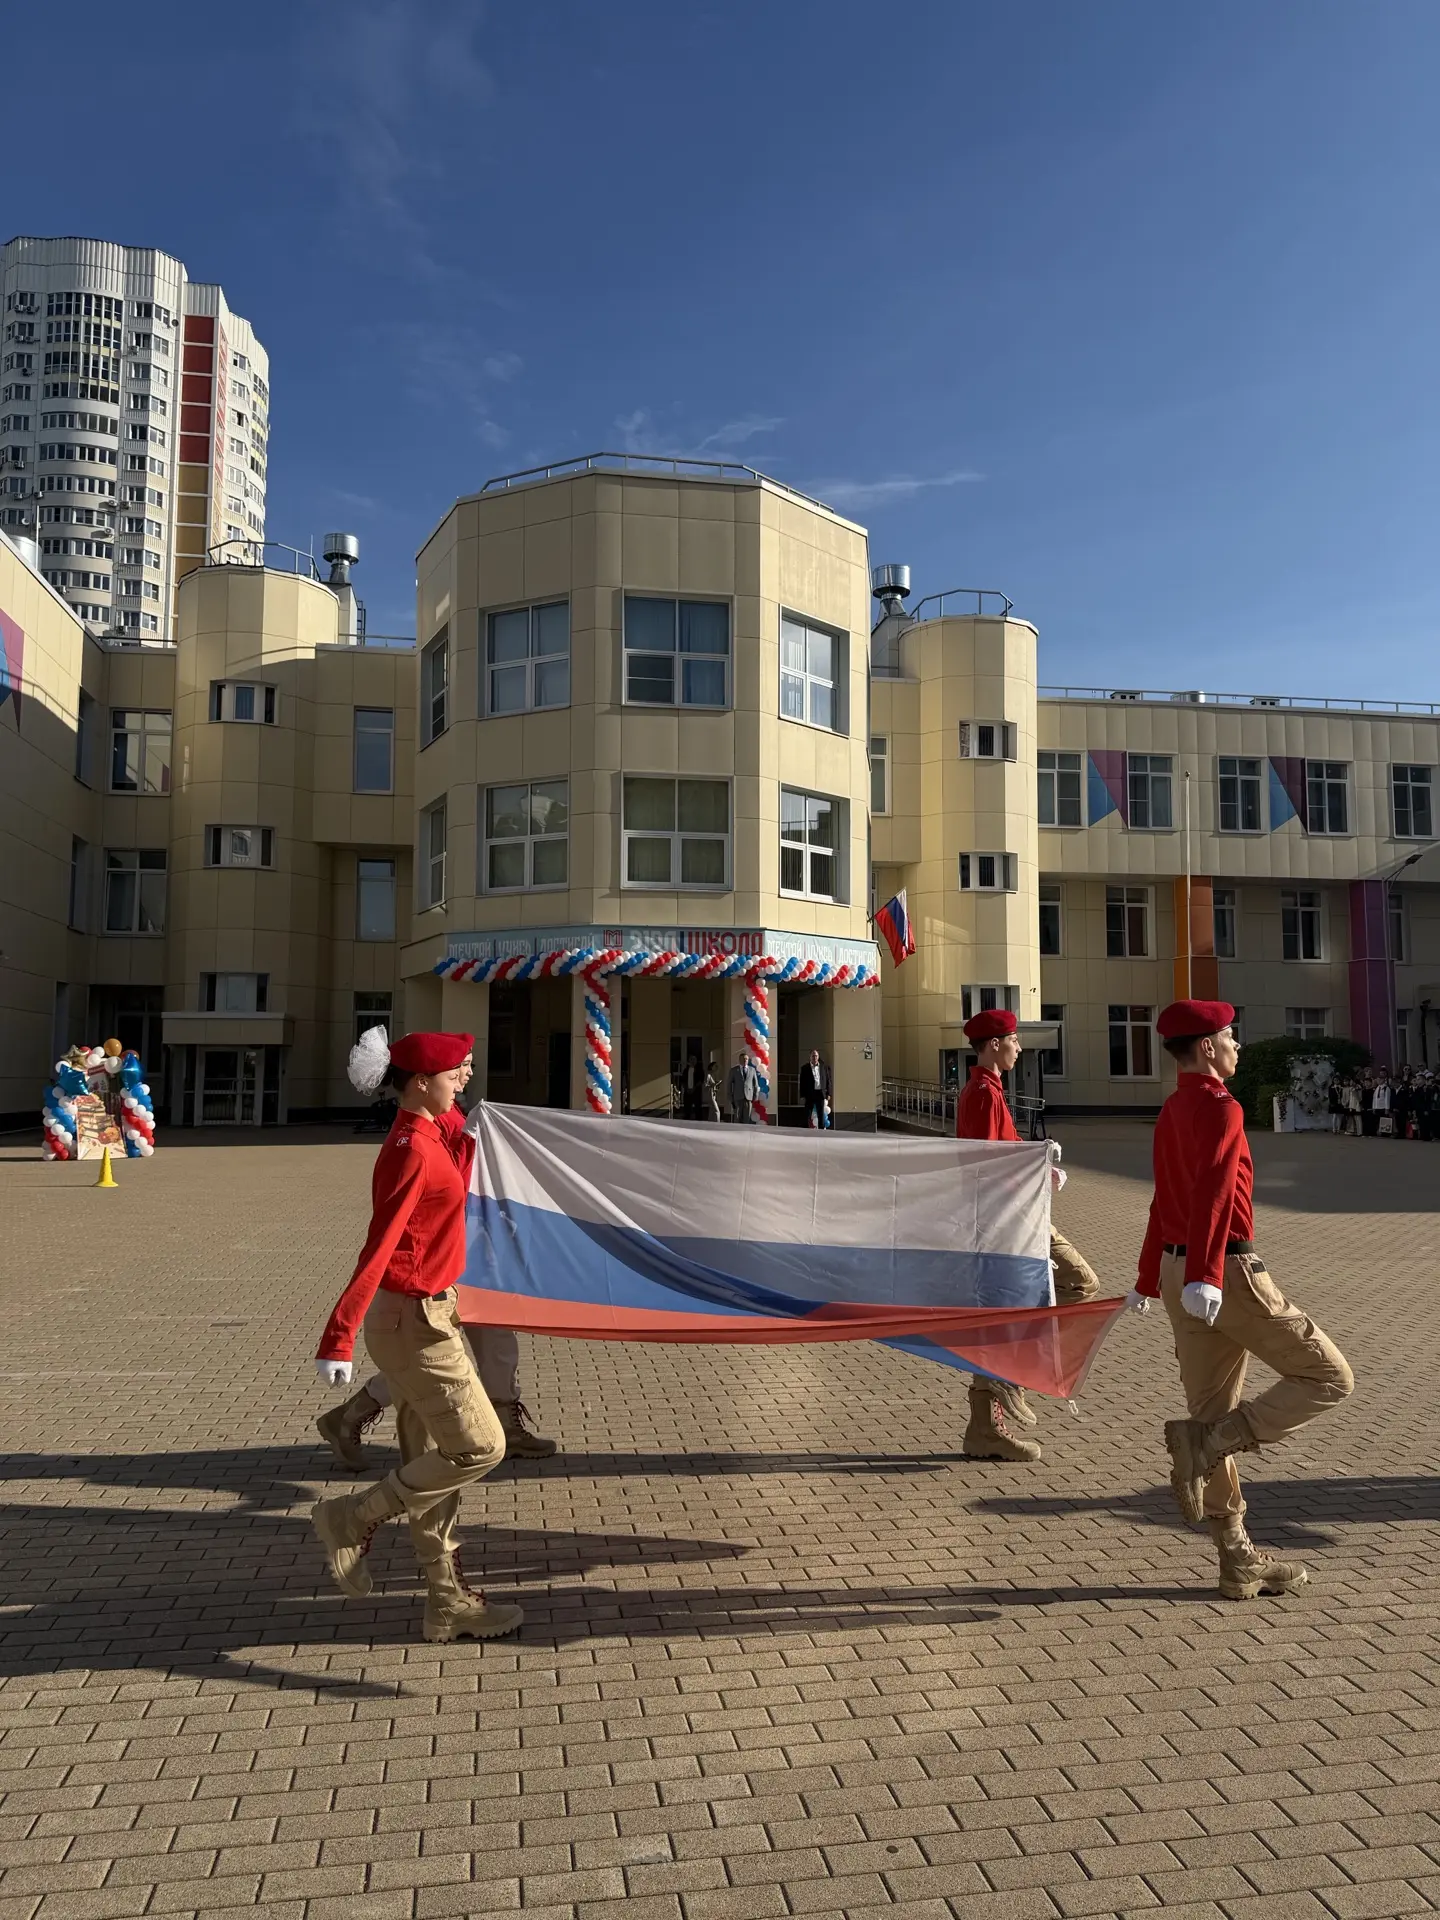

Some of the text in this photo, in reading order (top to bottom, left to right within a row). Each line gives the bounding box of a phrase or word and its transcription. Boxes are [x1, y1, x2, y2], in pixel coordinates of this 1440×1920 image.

[448, 939, 492, 958] МЕЧТАЙ
[498, 939, 531, 957] УЧИСЬ
[688, 931, 763, 957] ШКОЛА
